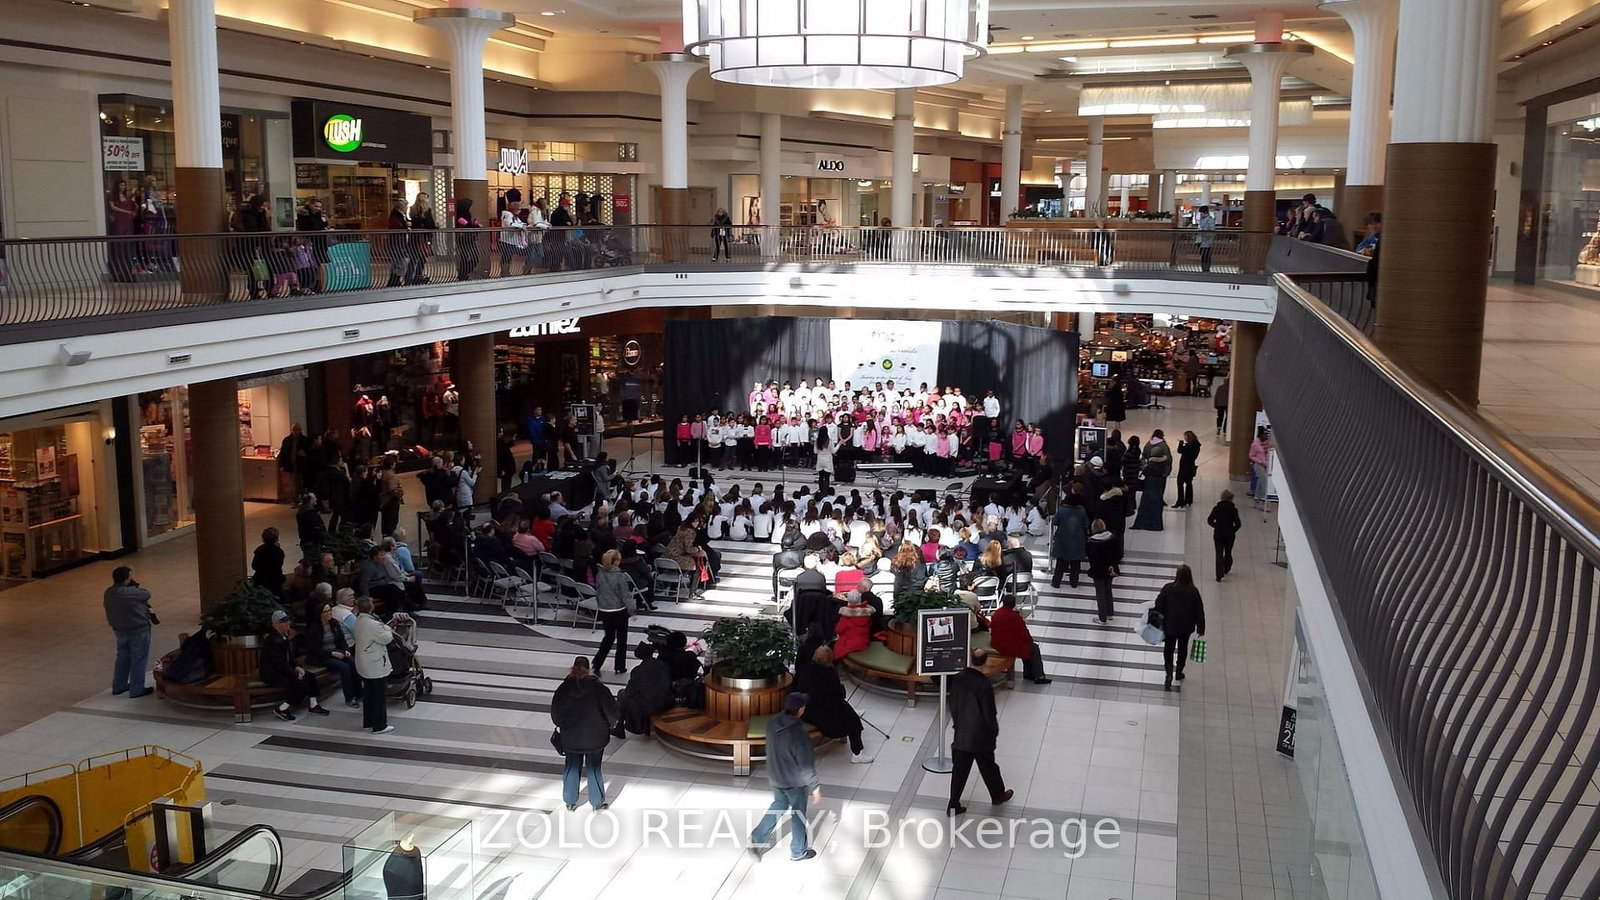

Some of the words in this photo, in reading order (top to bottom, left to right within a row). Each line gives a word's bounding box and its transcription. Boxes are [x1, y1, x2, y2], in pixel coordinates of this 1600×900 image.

[327, 118, 361, 141] LUSH
[107, 144, 130, 157] 50%
[818, 159, 845, 171] ALDO
